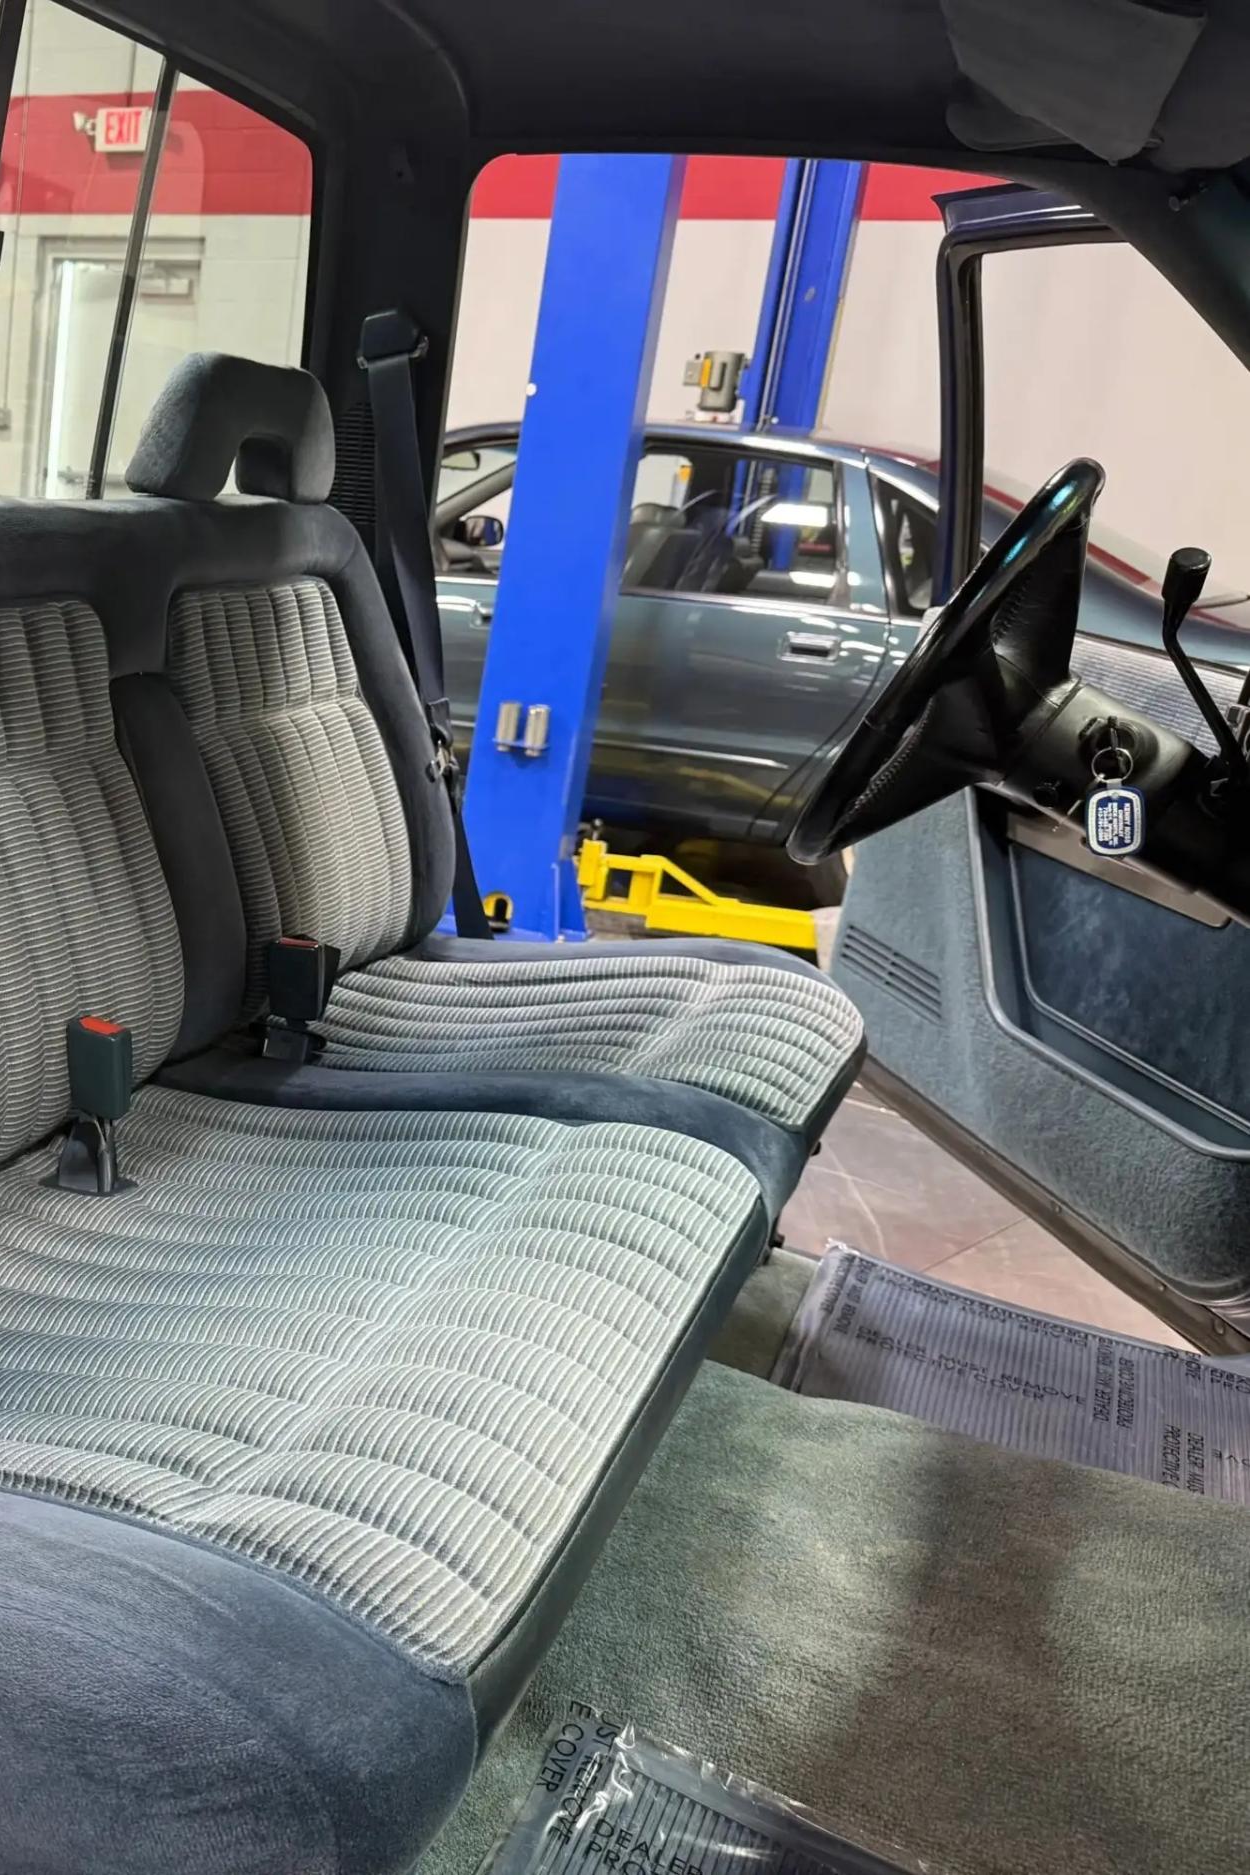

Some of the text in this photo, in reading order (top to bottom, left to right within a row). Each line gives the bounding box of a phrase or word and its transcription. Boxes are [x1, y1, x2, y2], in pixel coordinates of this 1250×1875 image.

[105, 110, 142, 145] EXIT
[855, 1332, 1045, 1402] PROTECTIVE COVER
[857, 1325, 1086, 1405] DEALER MUST REMOVE
[1117, 1356, 1135, 1430] PROTECTIVE COVER
[1093, 1388, 1111, 1422] DEALER
[1162, 1424, 1180, 1481] PROTECTIVE
[1187, 1432, 1205, 1468] DEALER
[536, 1723, 584, 1793] COVER
[547, 1754, 603, 1845] REMOVE
